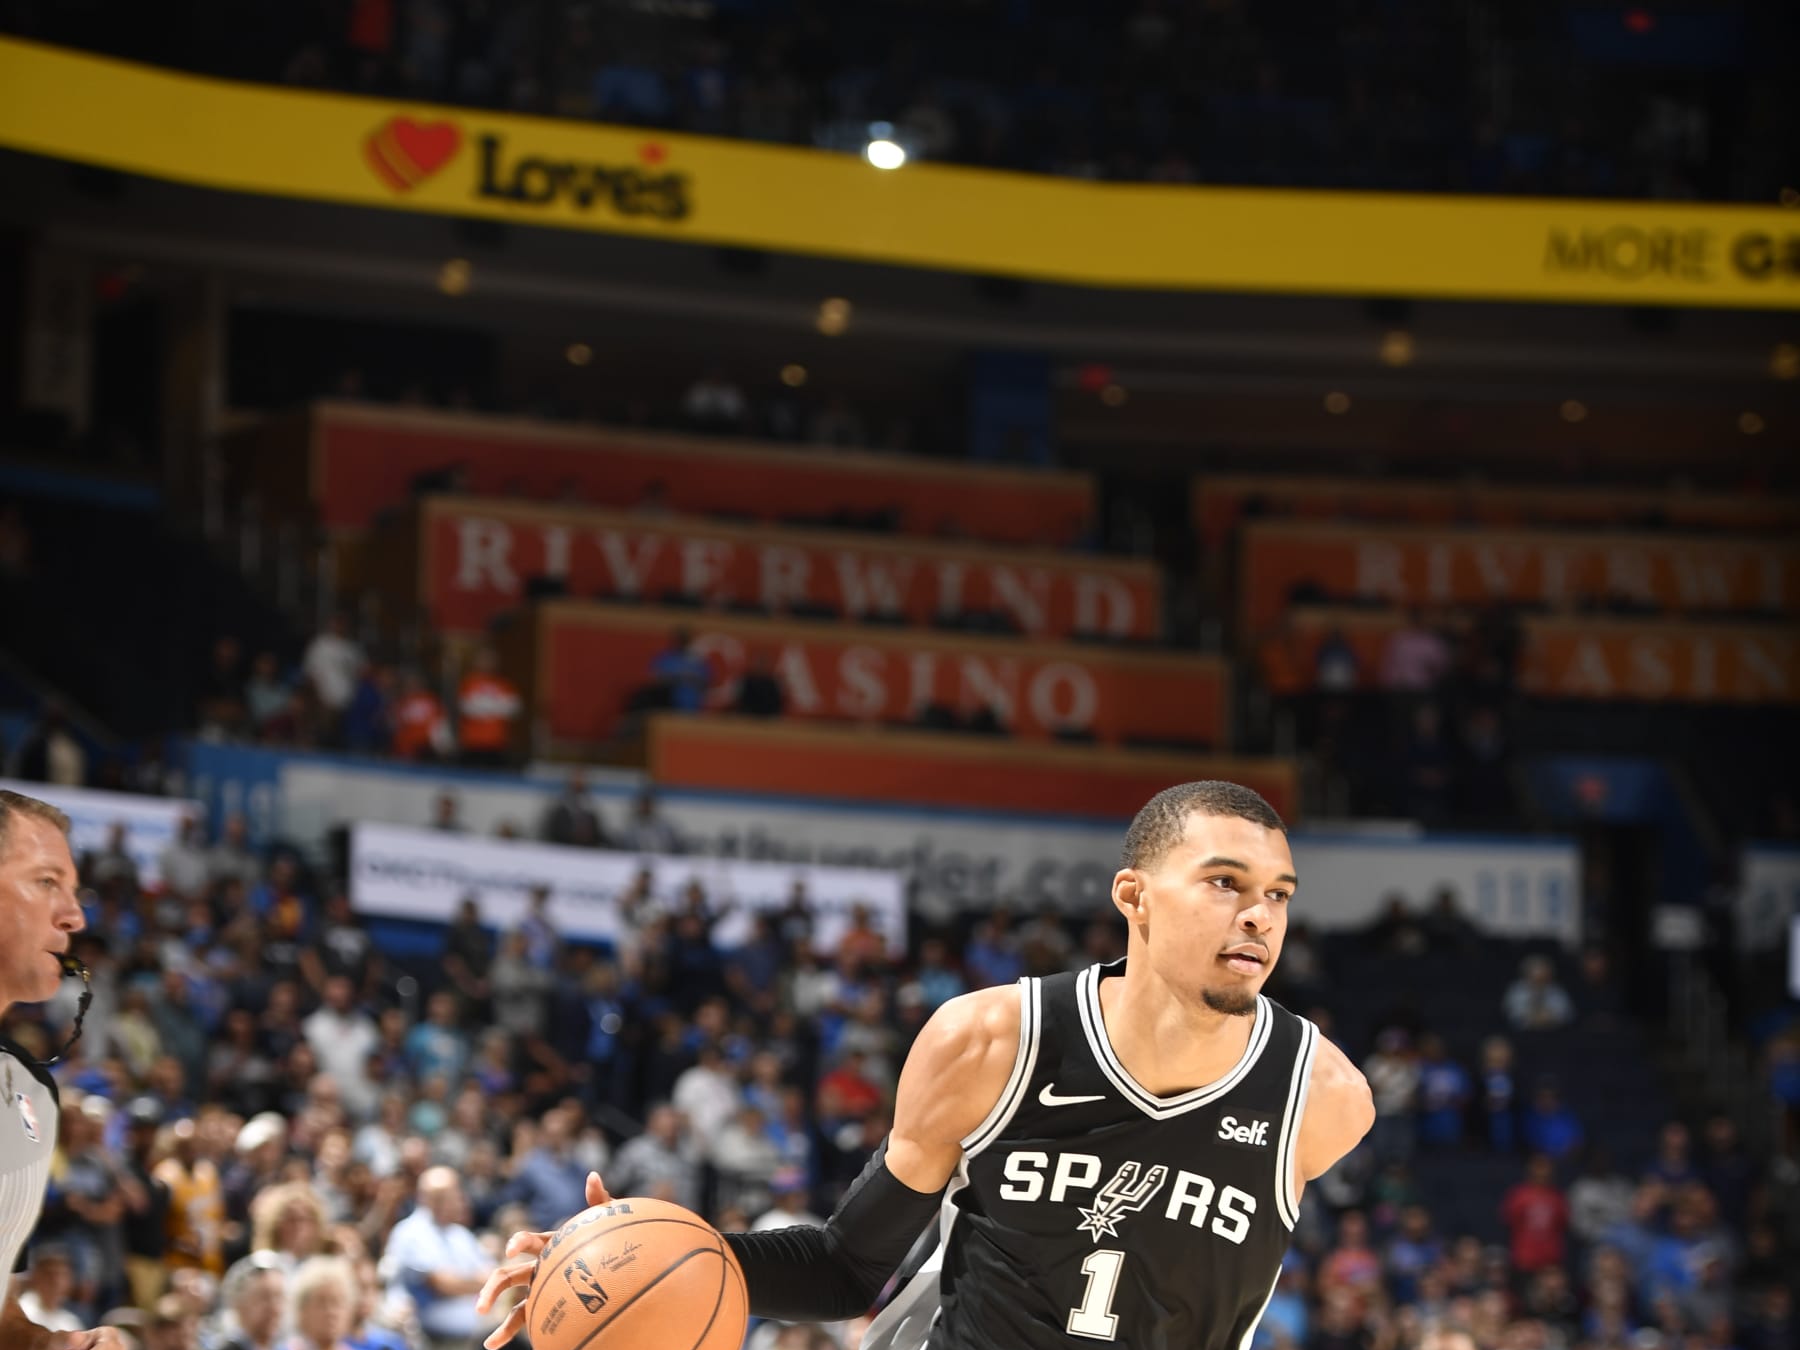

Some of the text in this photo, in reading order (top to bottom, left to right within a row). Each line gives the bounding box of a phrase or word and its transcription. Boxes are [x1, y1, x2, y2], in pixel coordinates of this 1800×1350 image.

[1544, 225, 1710, 281] MORE
[455, 517, 1135, 638] RIVERWIND
[1218, 1116, 1269, 1146] Self.
[1000, 1151, 1257, 1245] SPURS
[1066, 1249, 1125, 1341] 1
